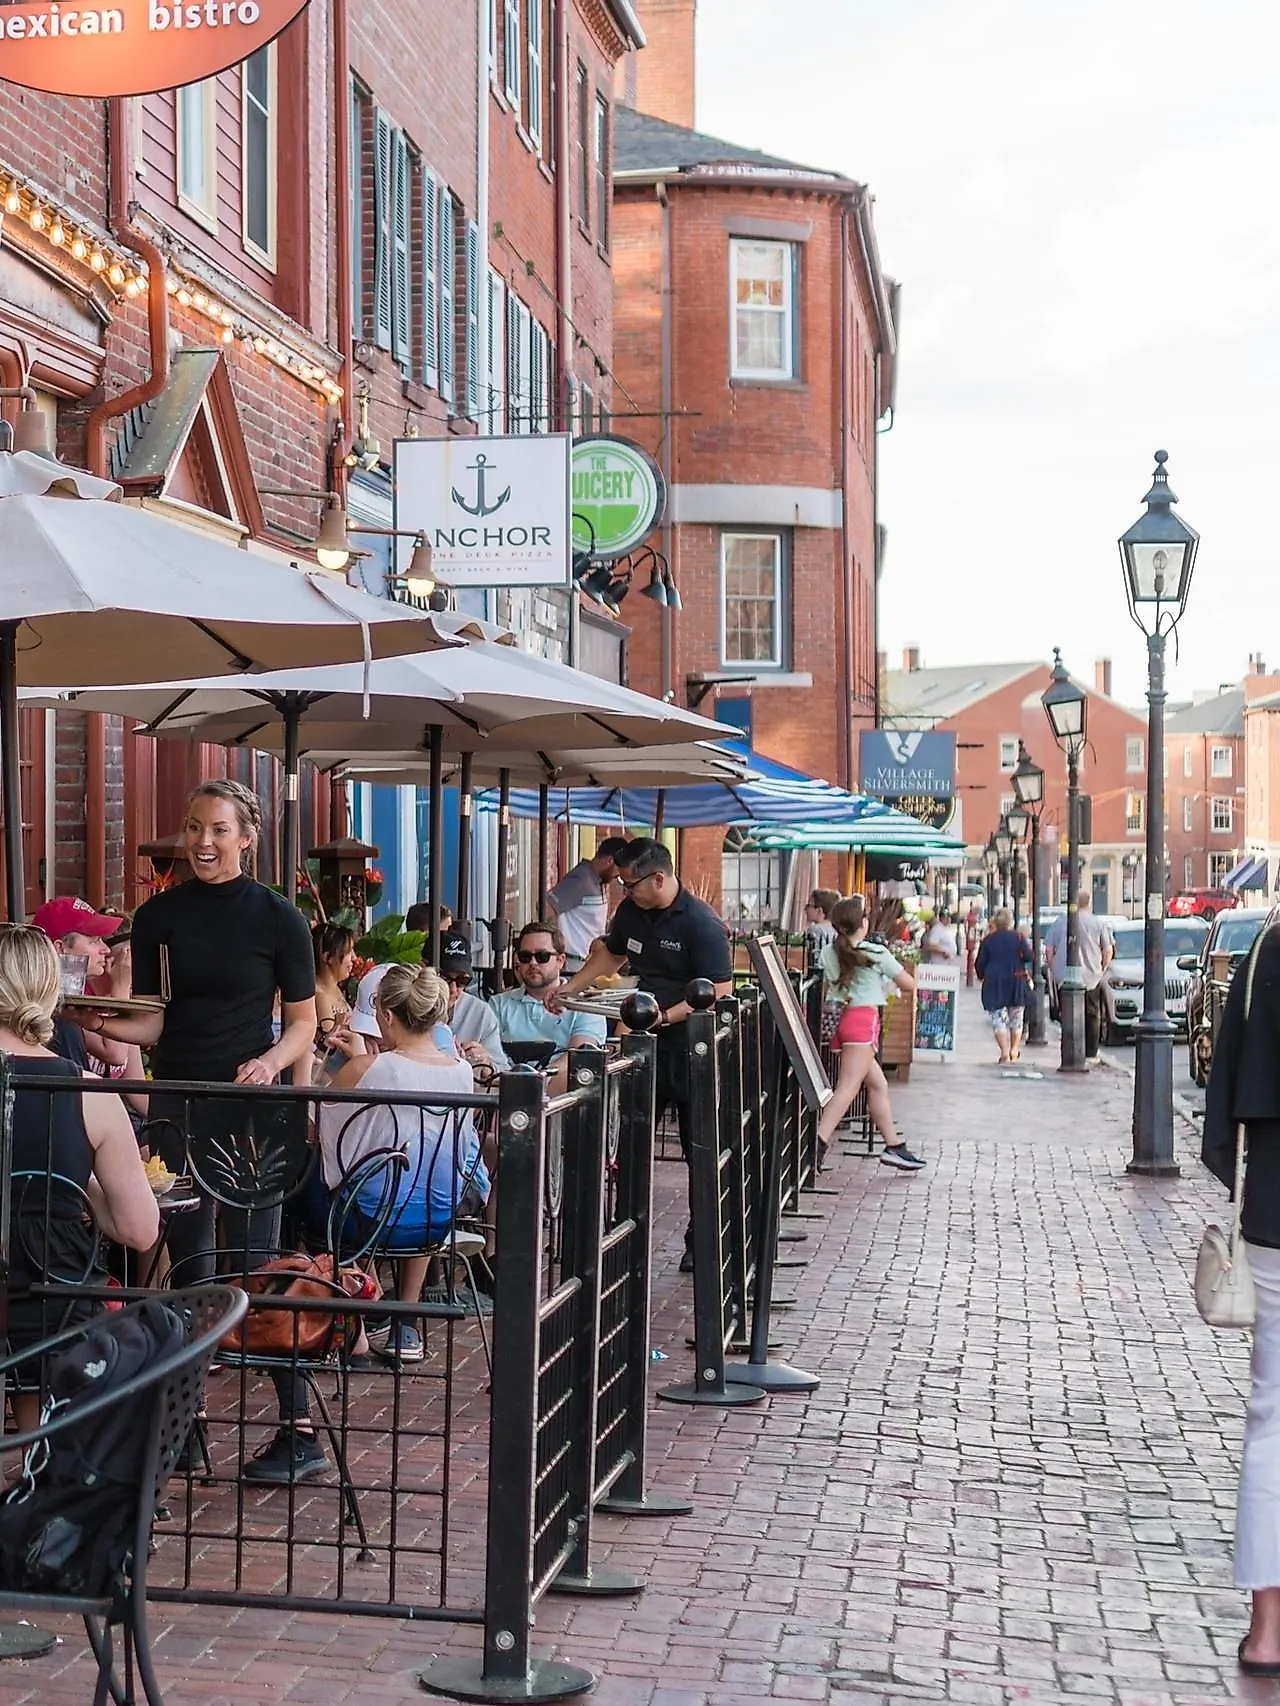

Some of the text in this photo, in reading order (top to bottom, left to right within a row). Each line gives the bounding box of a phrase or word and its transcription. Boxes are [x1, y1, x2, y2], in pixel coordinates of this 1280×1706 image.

[148, 0, 261, 30] bistro
[590, 456, 607, 470] THE
[572, 471, 636, 499] UICERY
[877, 767, 936, 779] VILLAGE
[863, 778, 951, 793] SILVERSMITH
